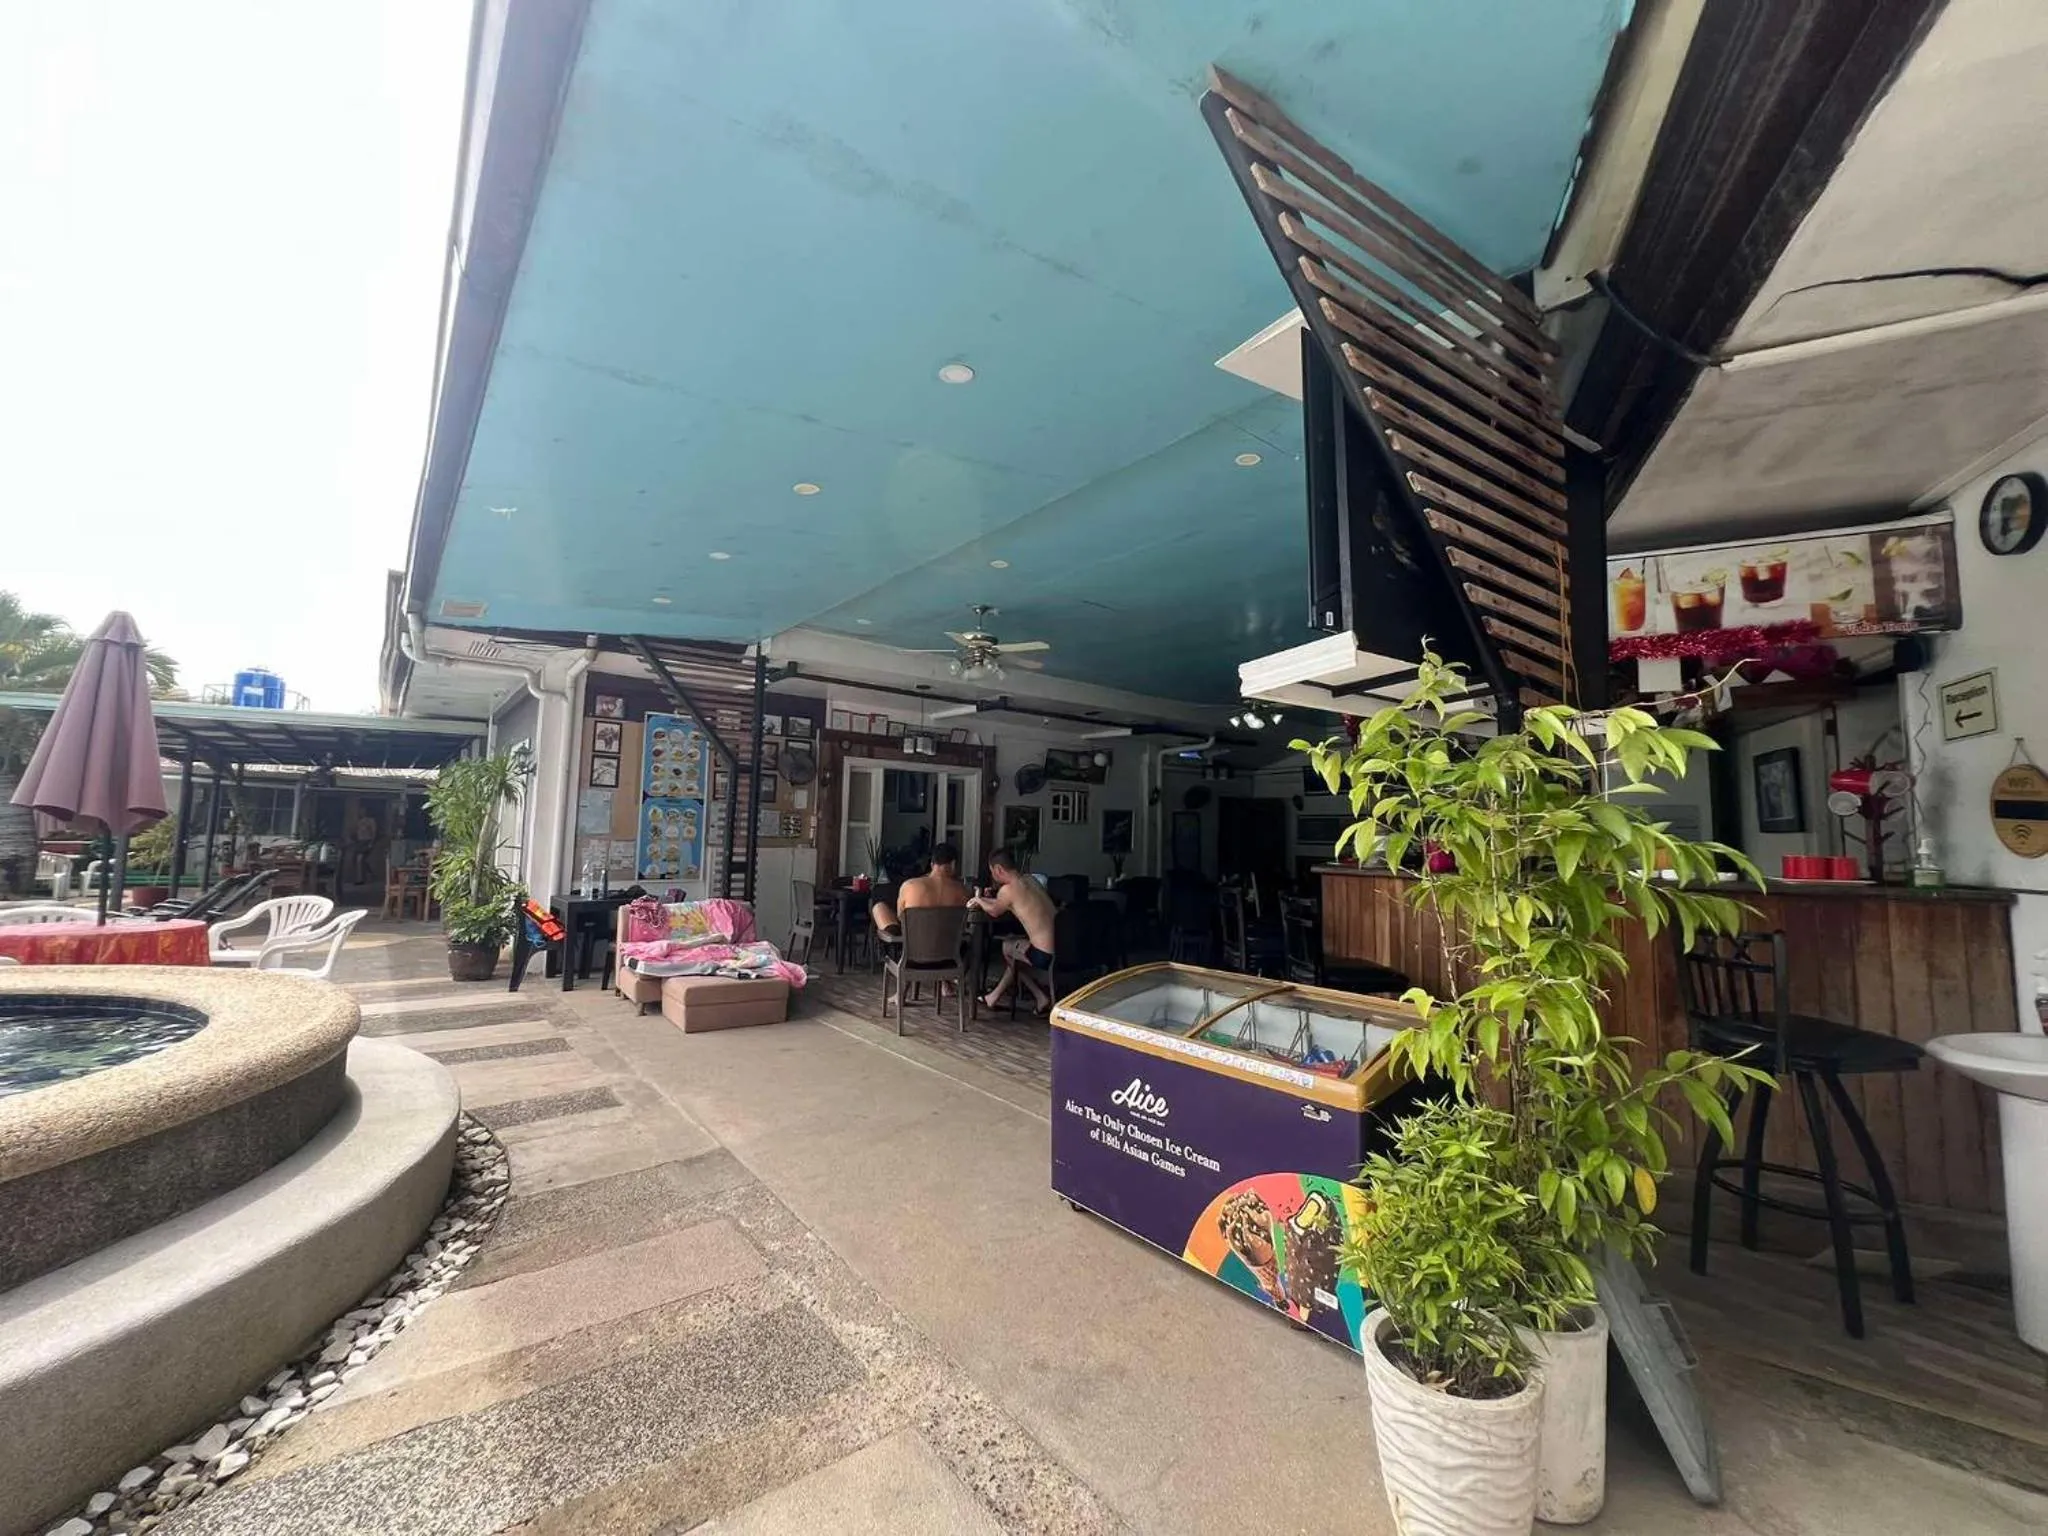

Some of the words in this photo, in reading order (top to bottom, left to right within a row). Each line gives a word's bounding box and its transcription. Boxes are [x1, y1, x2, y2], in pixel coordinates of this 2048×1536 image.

[1946, 686, 1987, 705] Reception
[1110, 1078, 1170, 1118] Aice
[1065, 1099, 1083, 1116] Aice
[1084, 1106, 1101, 1124] The
[1103, 1114, 1126, 1137] Only
[1127, 1123, 1163, 1149] Chosen
[1165, 1137, 1182, 1156] Ice
[1184, 1146, 1221, 1173] Cream
[1090, 1128, 1100, 1140] of
[1101, 1132, 1121, 1150] 18th
[1122, 1141, 1149, 1162] Asian
[1151, 1151, 1186, 1178] Games
